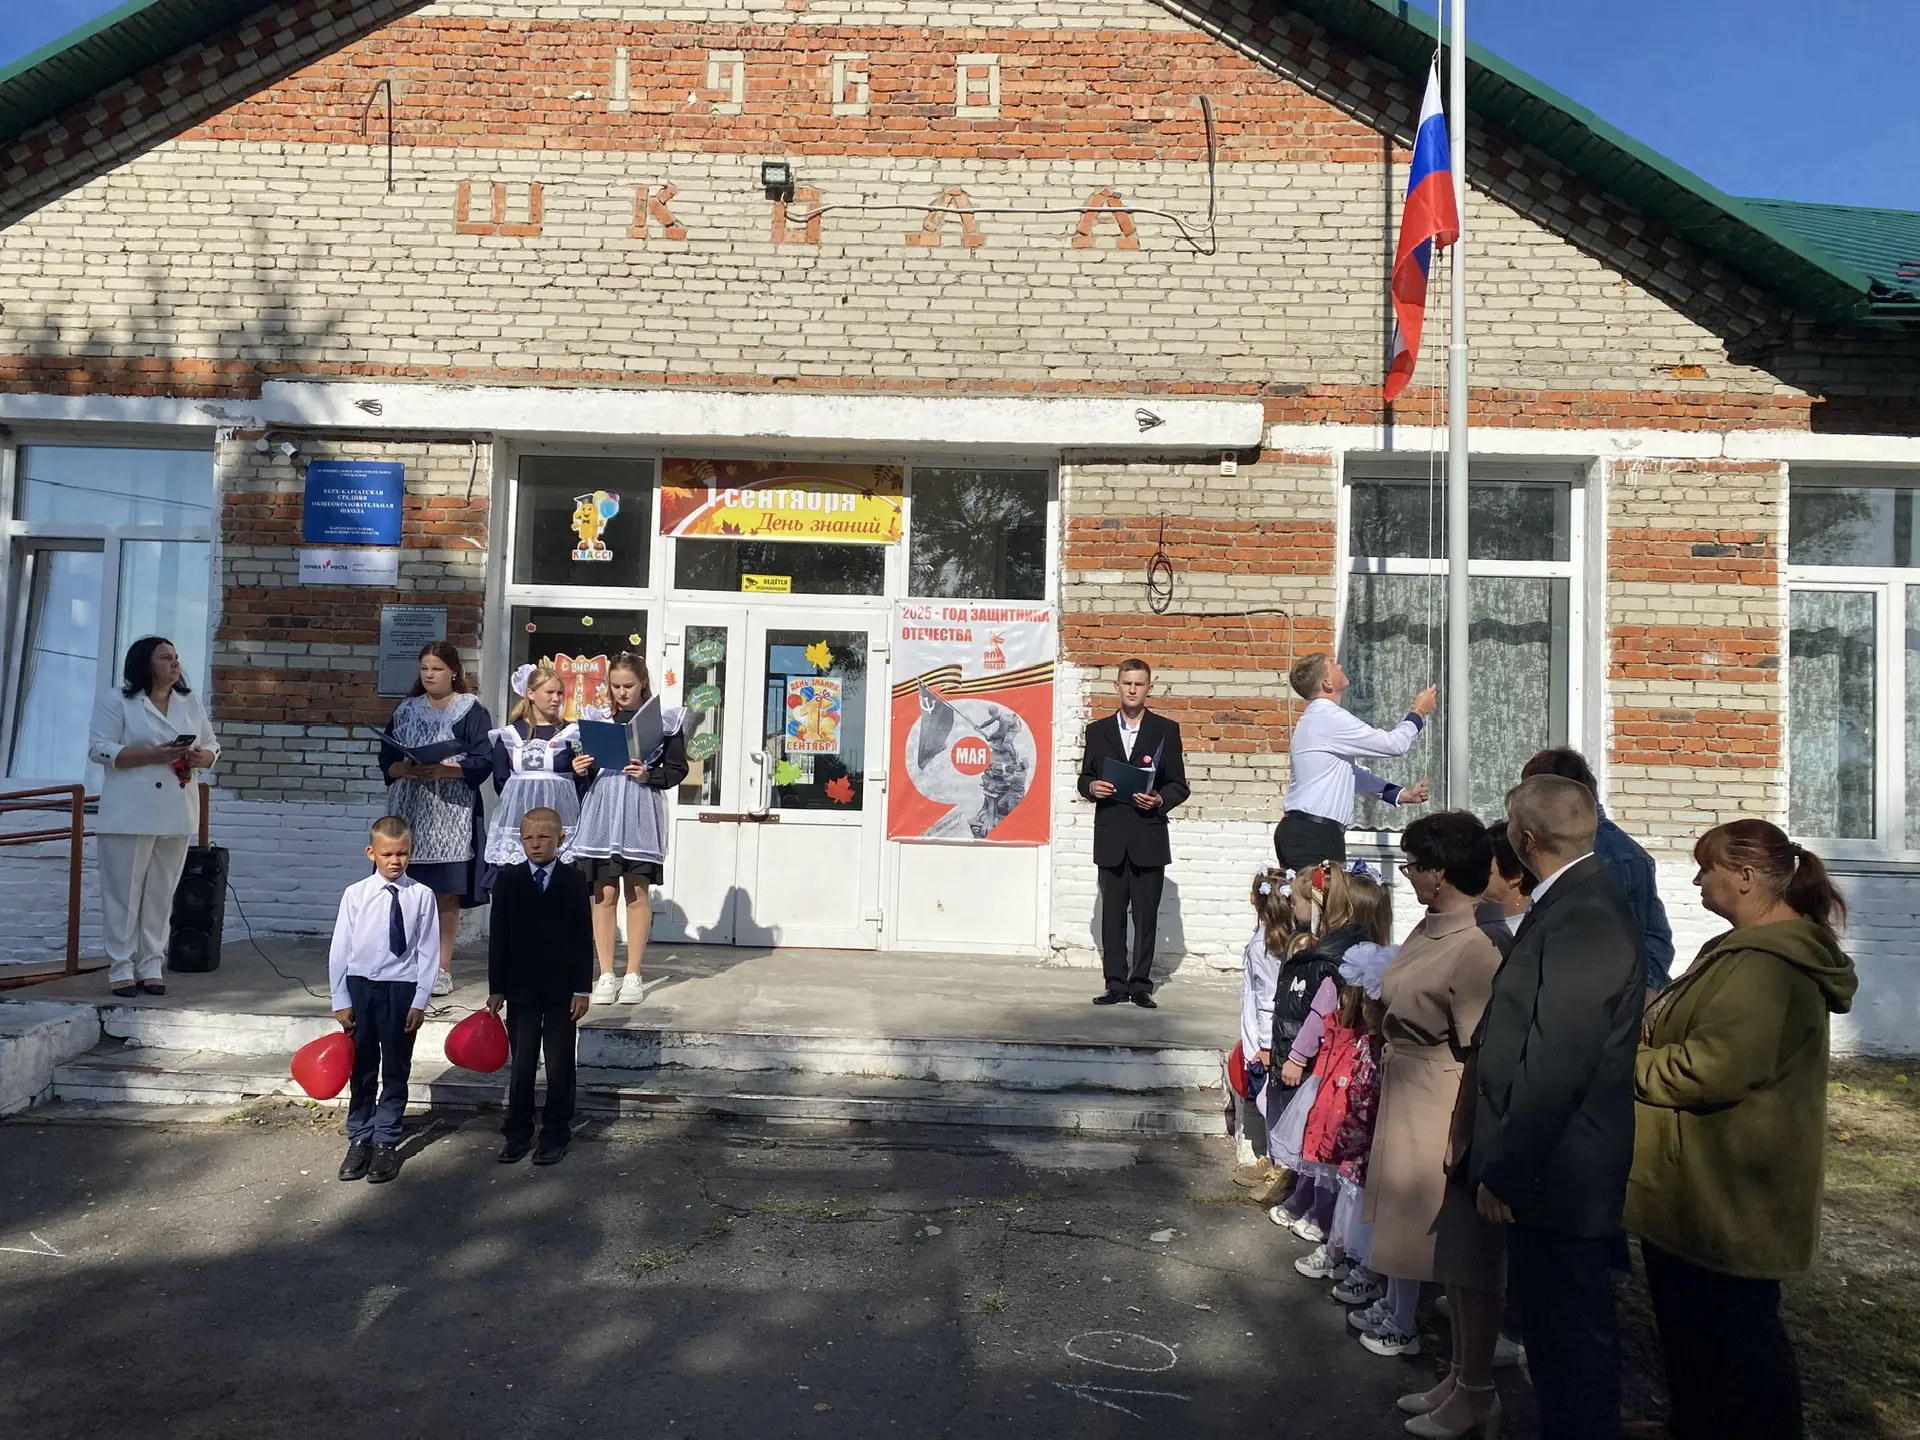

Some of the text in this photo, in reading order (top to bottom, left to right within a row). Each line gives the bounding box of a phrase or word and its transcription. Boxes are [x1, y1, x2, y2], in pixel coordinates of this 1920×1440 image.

[608, 45, 1001, 118] 1968
[456, 179, 1141, 250] ШКОЛА
[703, 475, 857, 514] 1 сентября
[757, 512, 804, 531] День
[810, 517, 881, 534] знаний
[902, 605, 932, 620] 2025
[942, 607, 968, 623] ГОД
[970, 608, 1051, 624] ЗАЩИТНИКА
[901, 627, 973, 642] ОТЕЧЕСТВА
[790, 680, 809, 692] ДЕНЬ
[787, 741, 838, 752] СЕНТЯБРЯ
[956, 747, 987, 765] МАЯ
